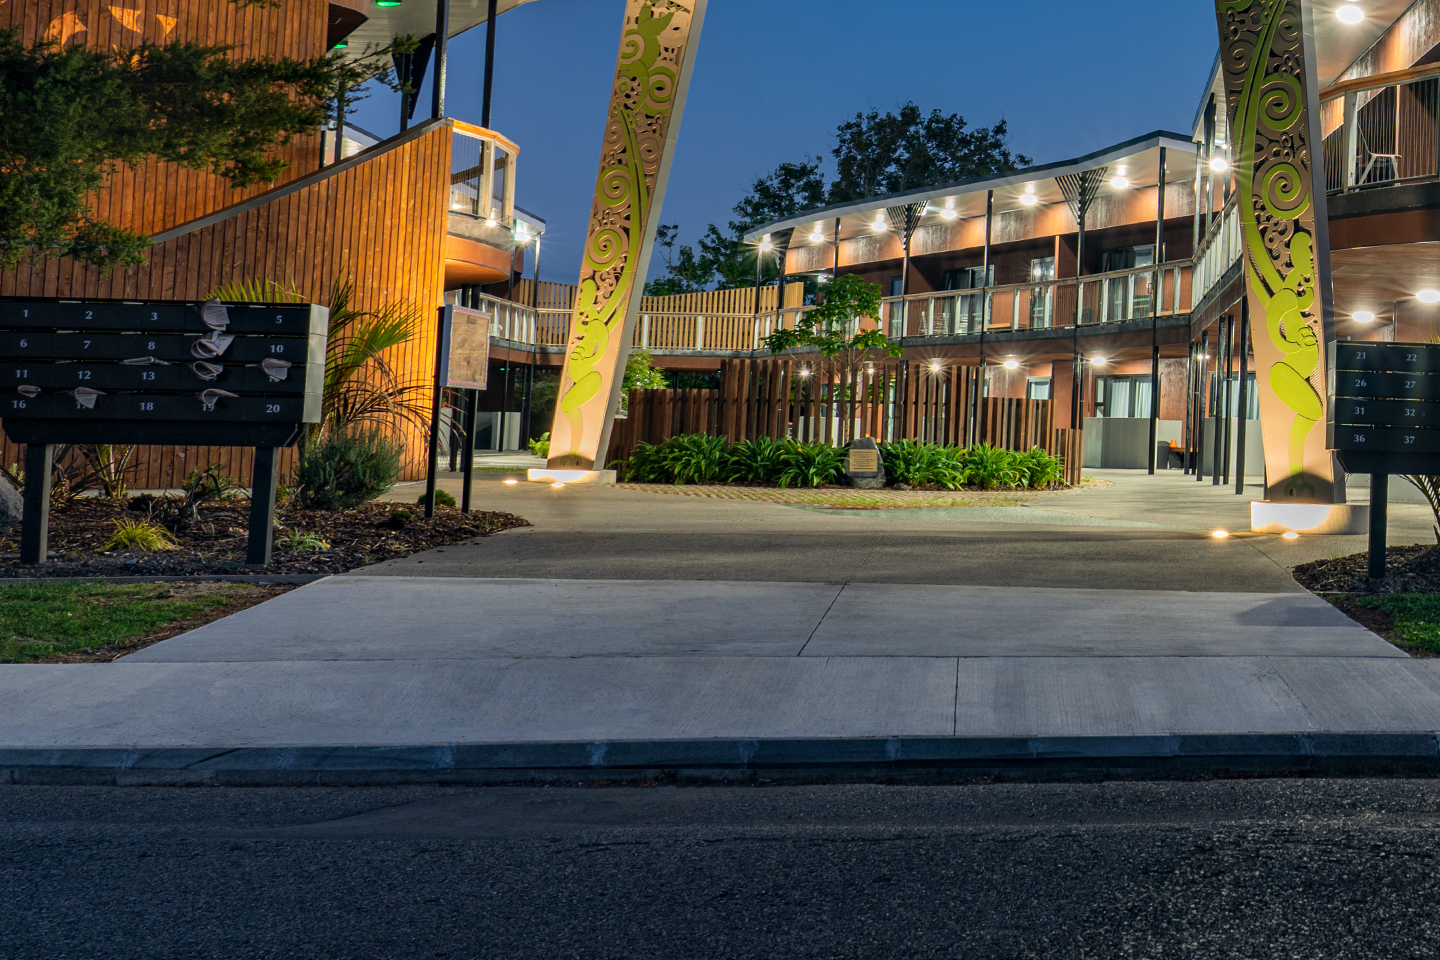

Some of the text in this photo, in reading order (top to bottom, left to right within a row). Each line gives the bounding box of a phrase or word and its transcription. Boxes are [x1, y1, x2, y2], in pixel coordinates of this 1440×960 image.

[85, 311, 92, 319] 2
[151, 312, 157, 320] 3
[276, 315, 282, 323] 5
[20, 339, 27, 347] 6
[84, 341, 91, 349] 7
[16, 370, 27, 378] 11
[78, 371, 91, 379] 12
[142, 372, 155, 380] 13
[12, 400, 26, 409] 16
[140, 402, 153, 410] 18
[202, 403, 215, 412] 19
